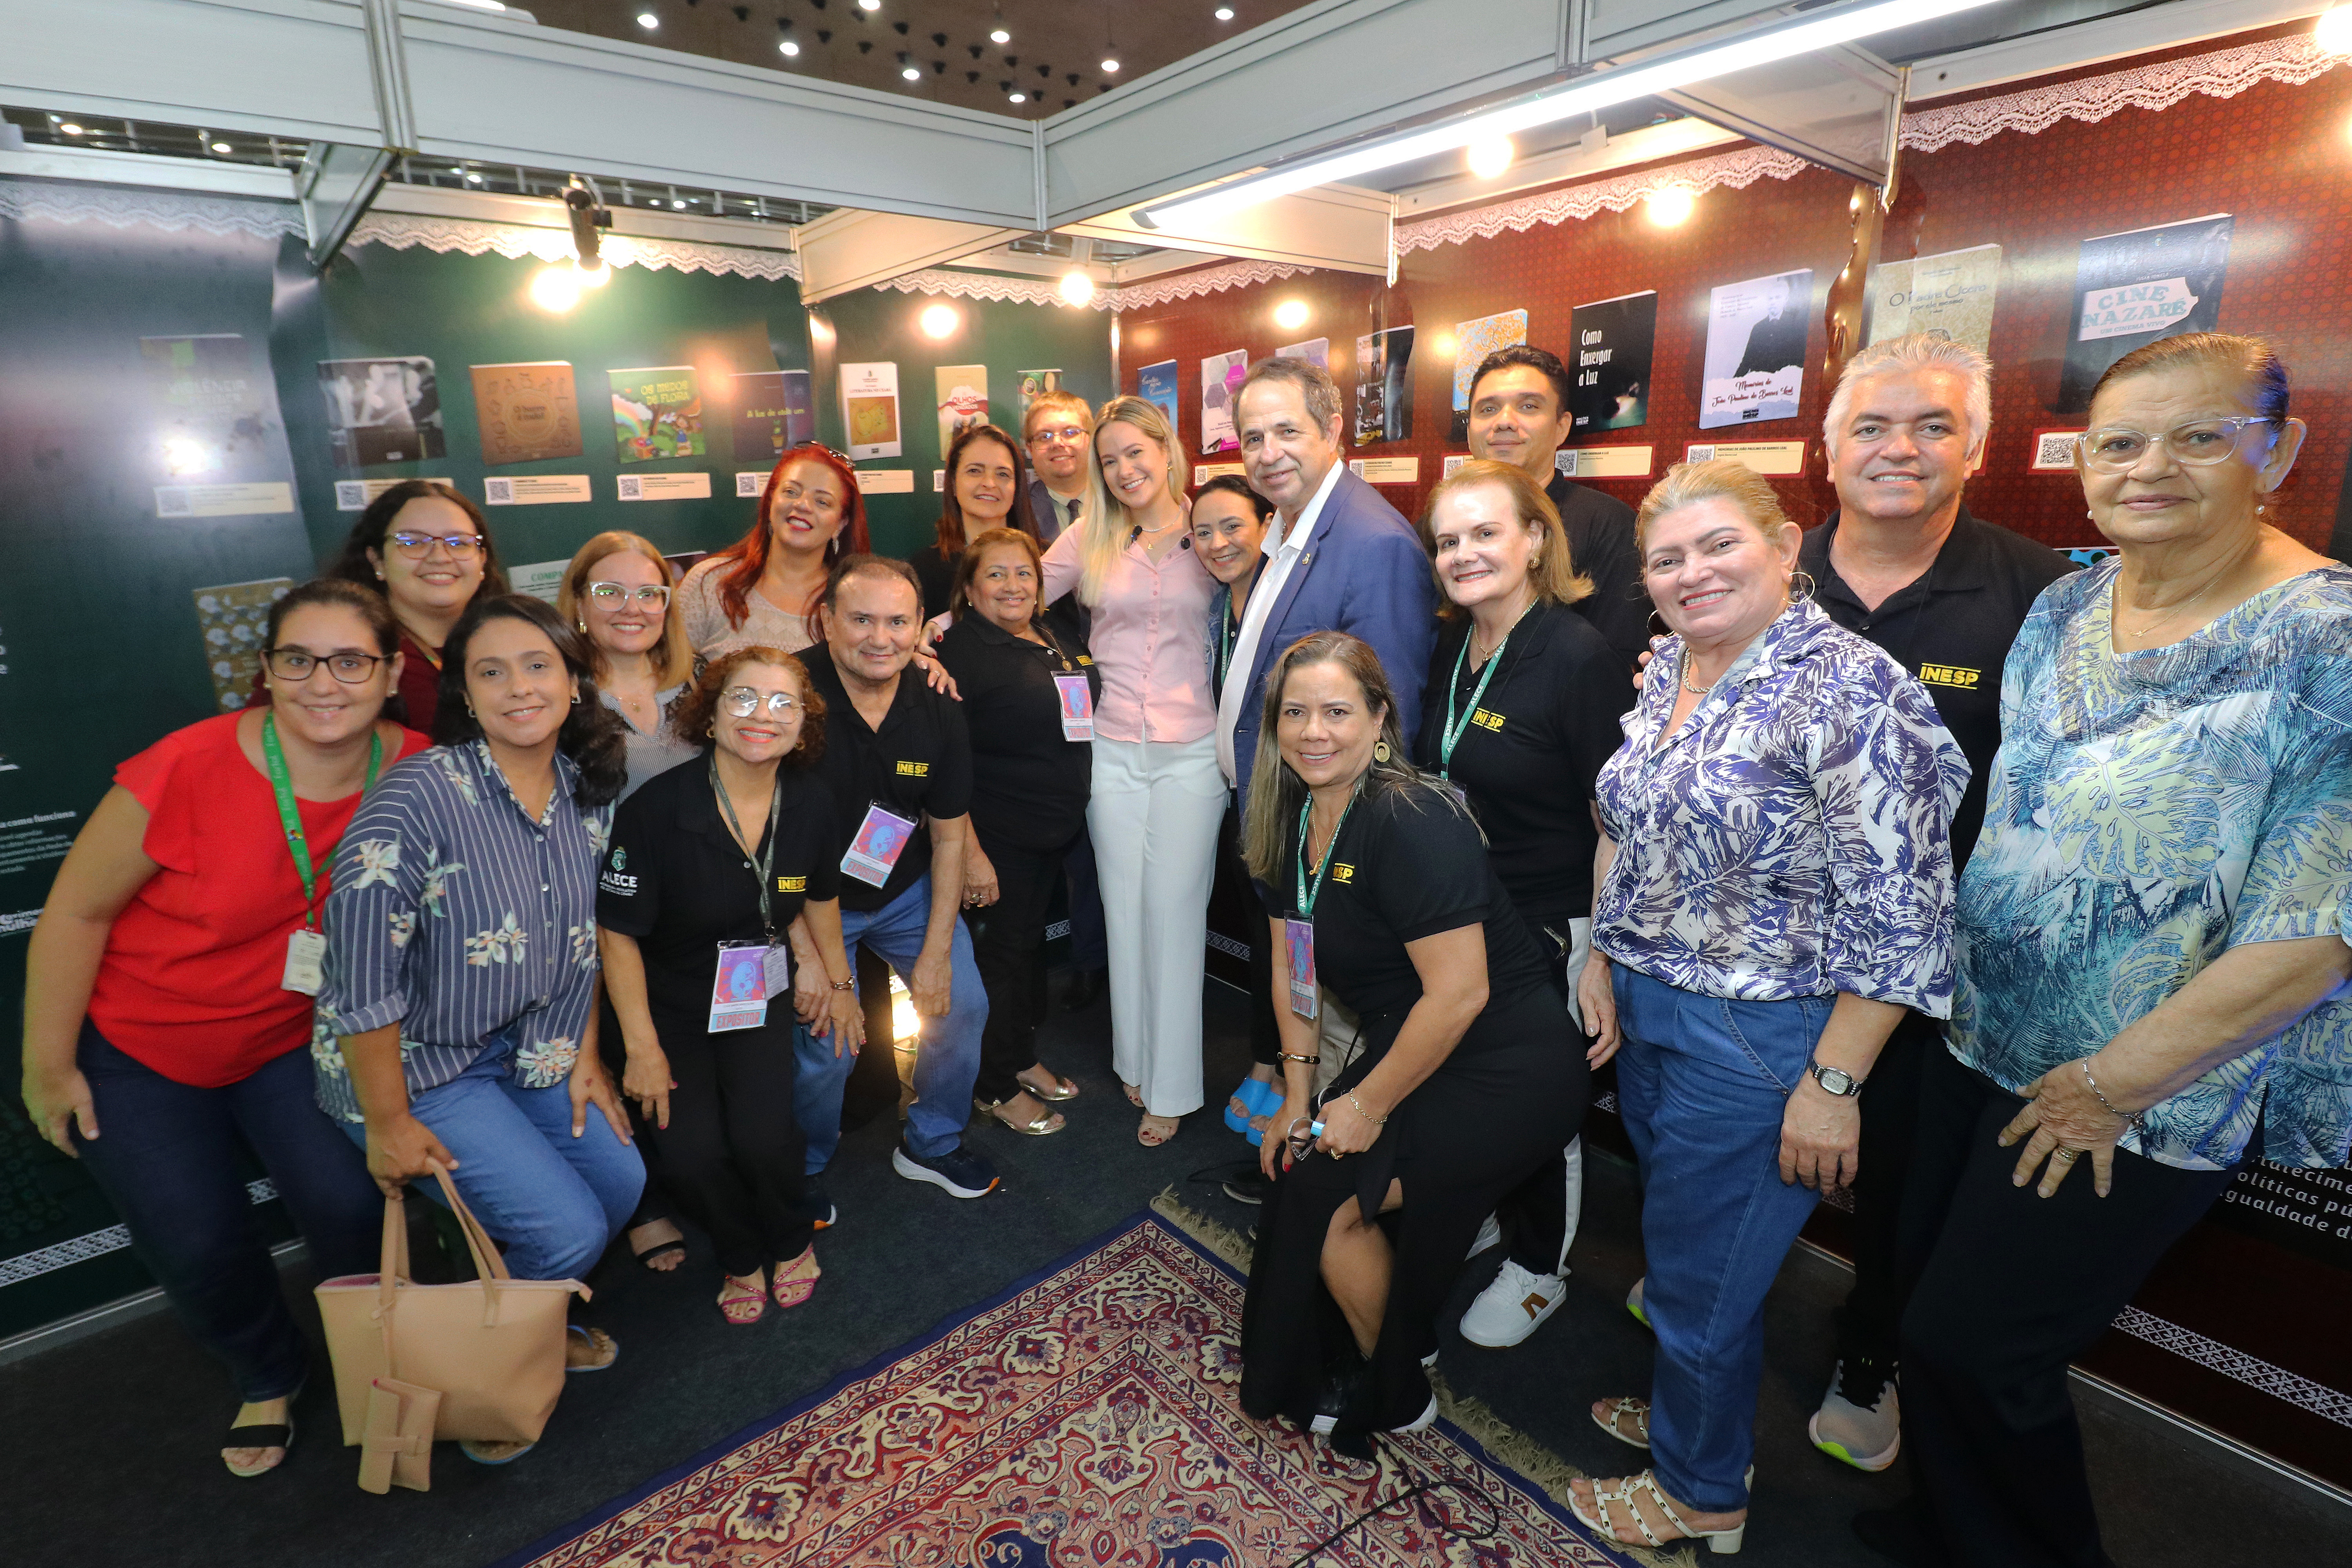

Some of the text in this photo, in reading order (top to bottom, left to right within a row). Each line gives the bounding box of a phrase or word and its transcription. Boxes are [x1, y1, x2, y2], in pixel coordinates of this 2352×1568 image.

[1890, 292, 1904, 307] O
[2098, 286, 2169, 310] CINE
[2082, 298, 2187, 328] NAZARÉ
[1581, 329, 1602, 346] Como
[2114, 323, 2144, 332] CINEMA
[1579, 348, 1613, 367] Enxergar
[1578, 373, 1584, 387] a
[661, 391, 690, 403] FLORA
[1918, 666, 1979, 686] INESP
[1470, 684, 1484, 707] ALECE
[1445, 716, 1453, 737] ALECE
[1446, 731, 1460, 753] ALECE
[896, 763, 928, 775] INESP
[602, 870, 638, 888] ALECE
[1311, 873, 1321, 896] ALECE
[2237, 1171, 2319, 1205] olíticas
[2220, 1190, 2352, 1240] gualdade d
